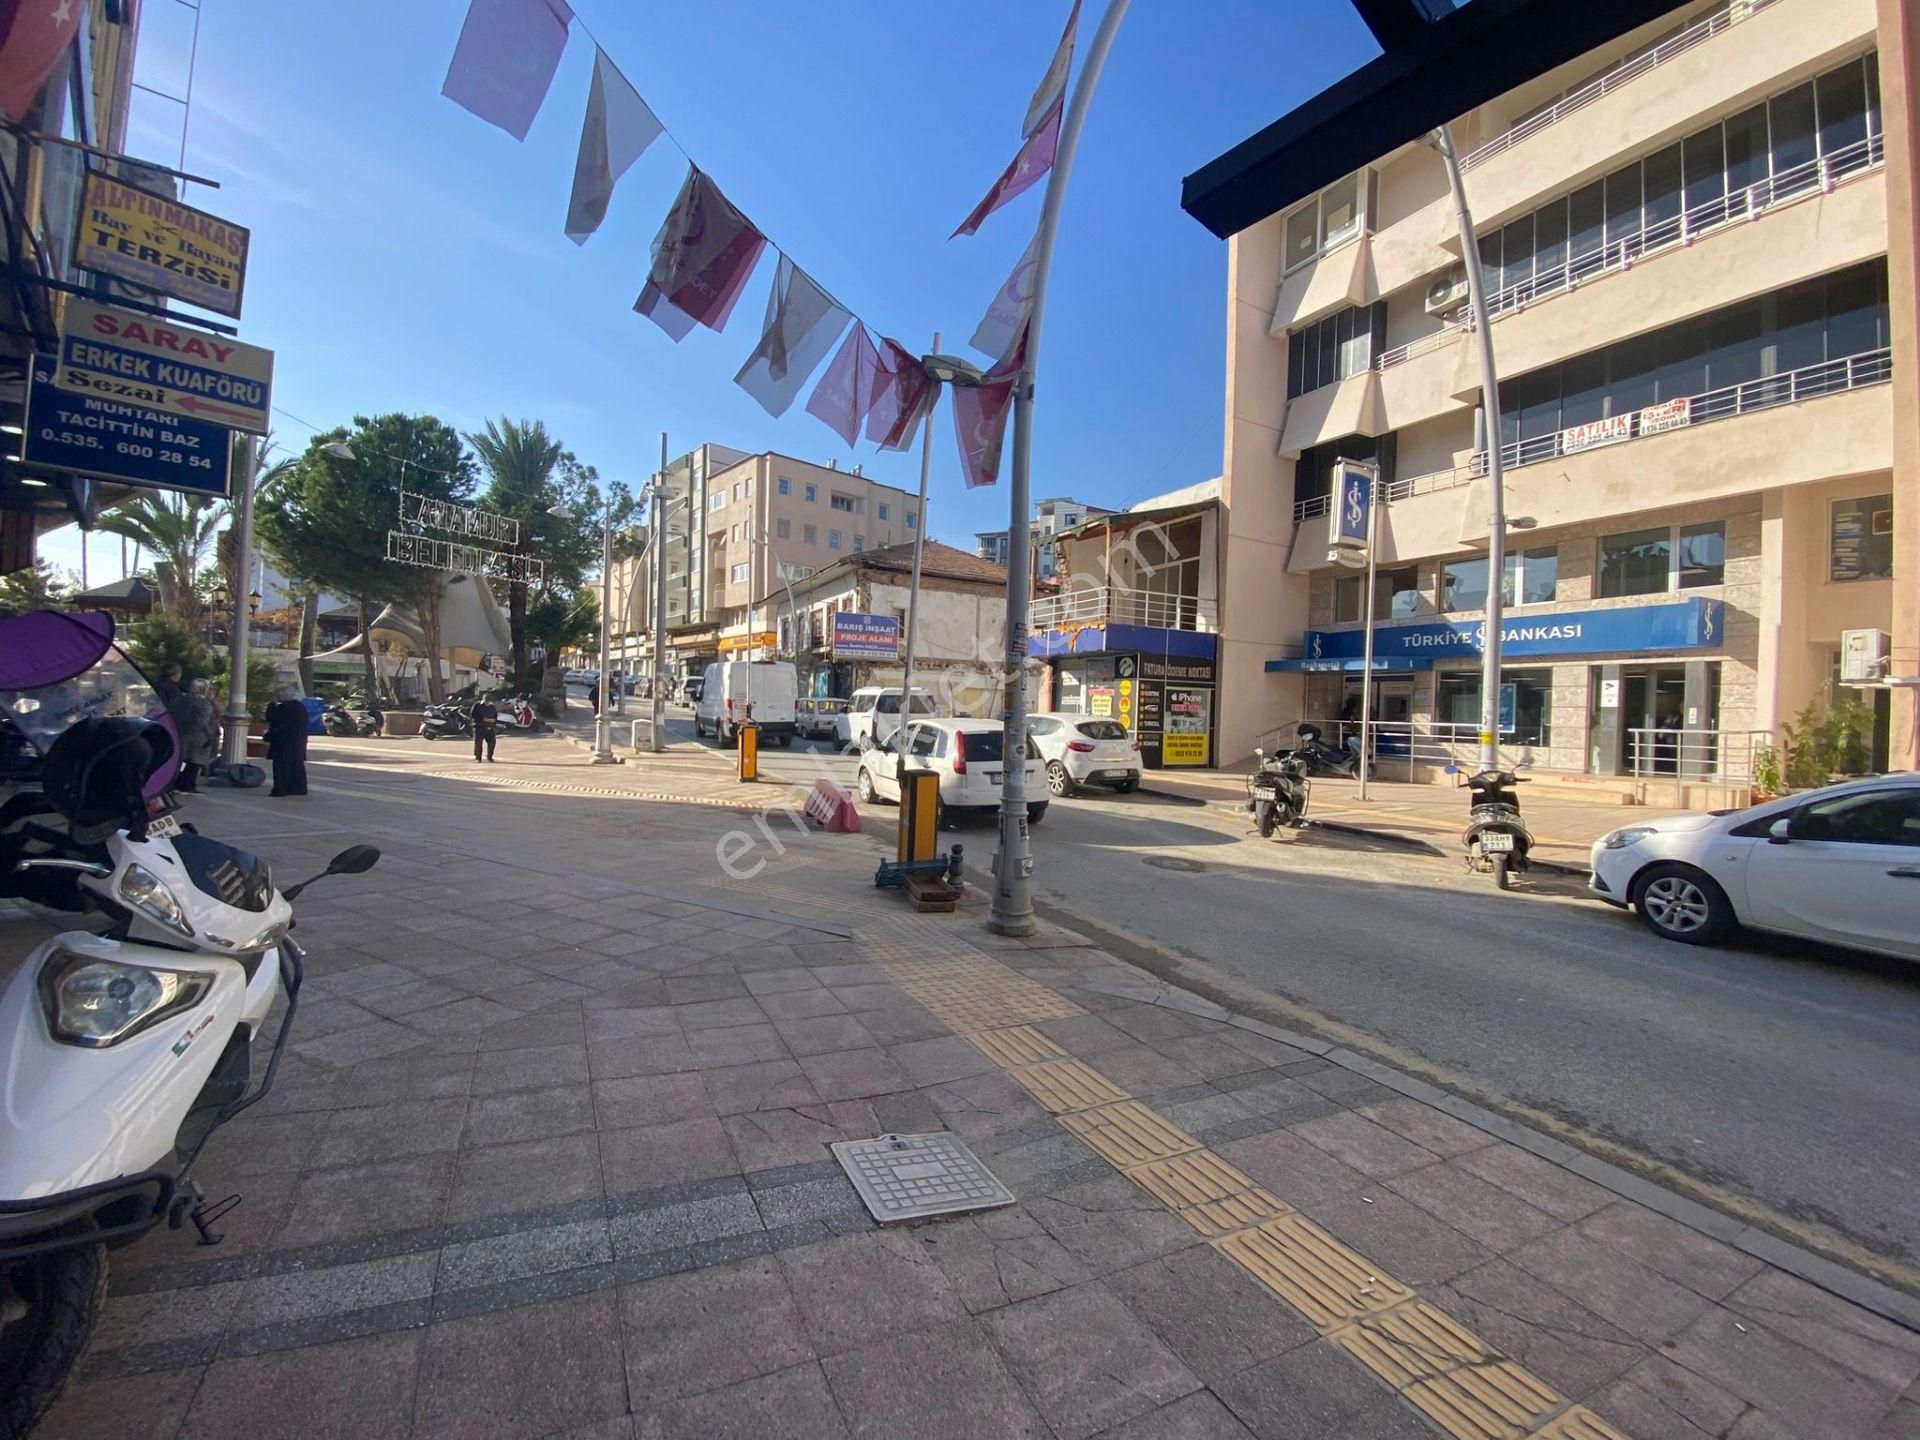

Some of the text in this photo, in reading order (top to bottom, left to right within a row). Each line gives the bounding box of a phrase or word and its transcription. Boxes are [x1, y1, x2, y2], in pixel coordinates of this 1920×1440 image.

[92, 208, 241, 273] Bay ve Bayan
[93, 313, 236, 363] SARAY
[67, 370, 166, 405] Sezai
[72, 343, 152, 379] ERKEK
[157, 364, 262, 405] KUAFÖRÜ
[57, 408, 201, 449] TACİTTİN BAZ
[1567, 415, 1627, 441] SATILIK
[41, 427, 213, 471] 0.535. 600 28 54
[837, 624, 864, 633] BARIŞ
[1402, 631, 1473, 648] TÜRKİYE
[1500, 624, 1582, 642] BANKASI
